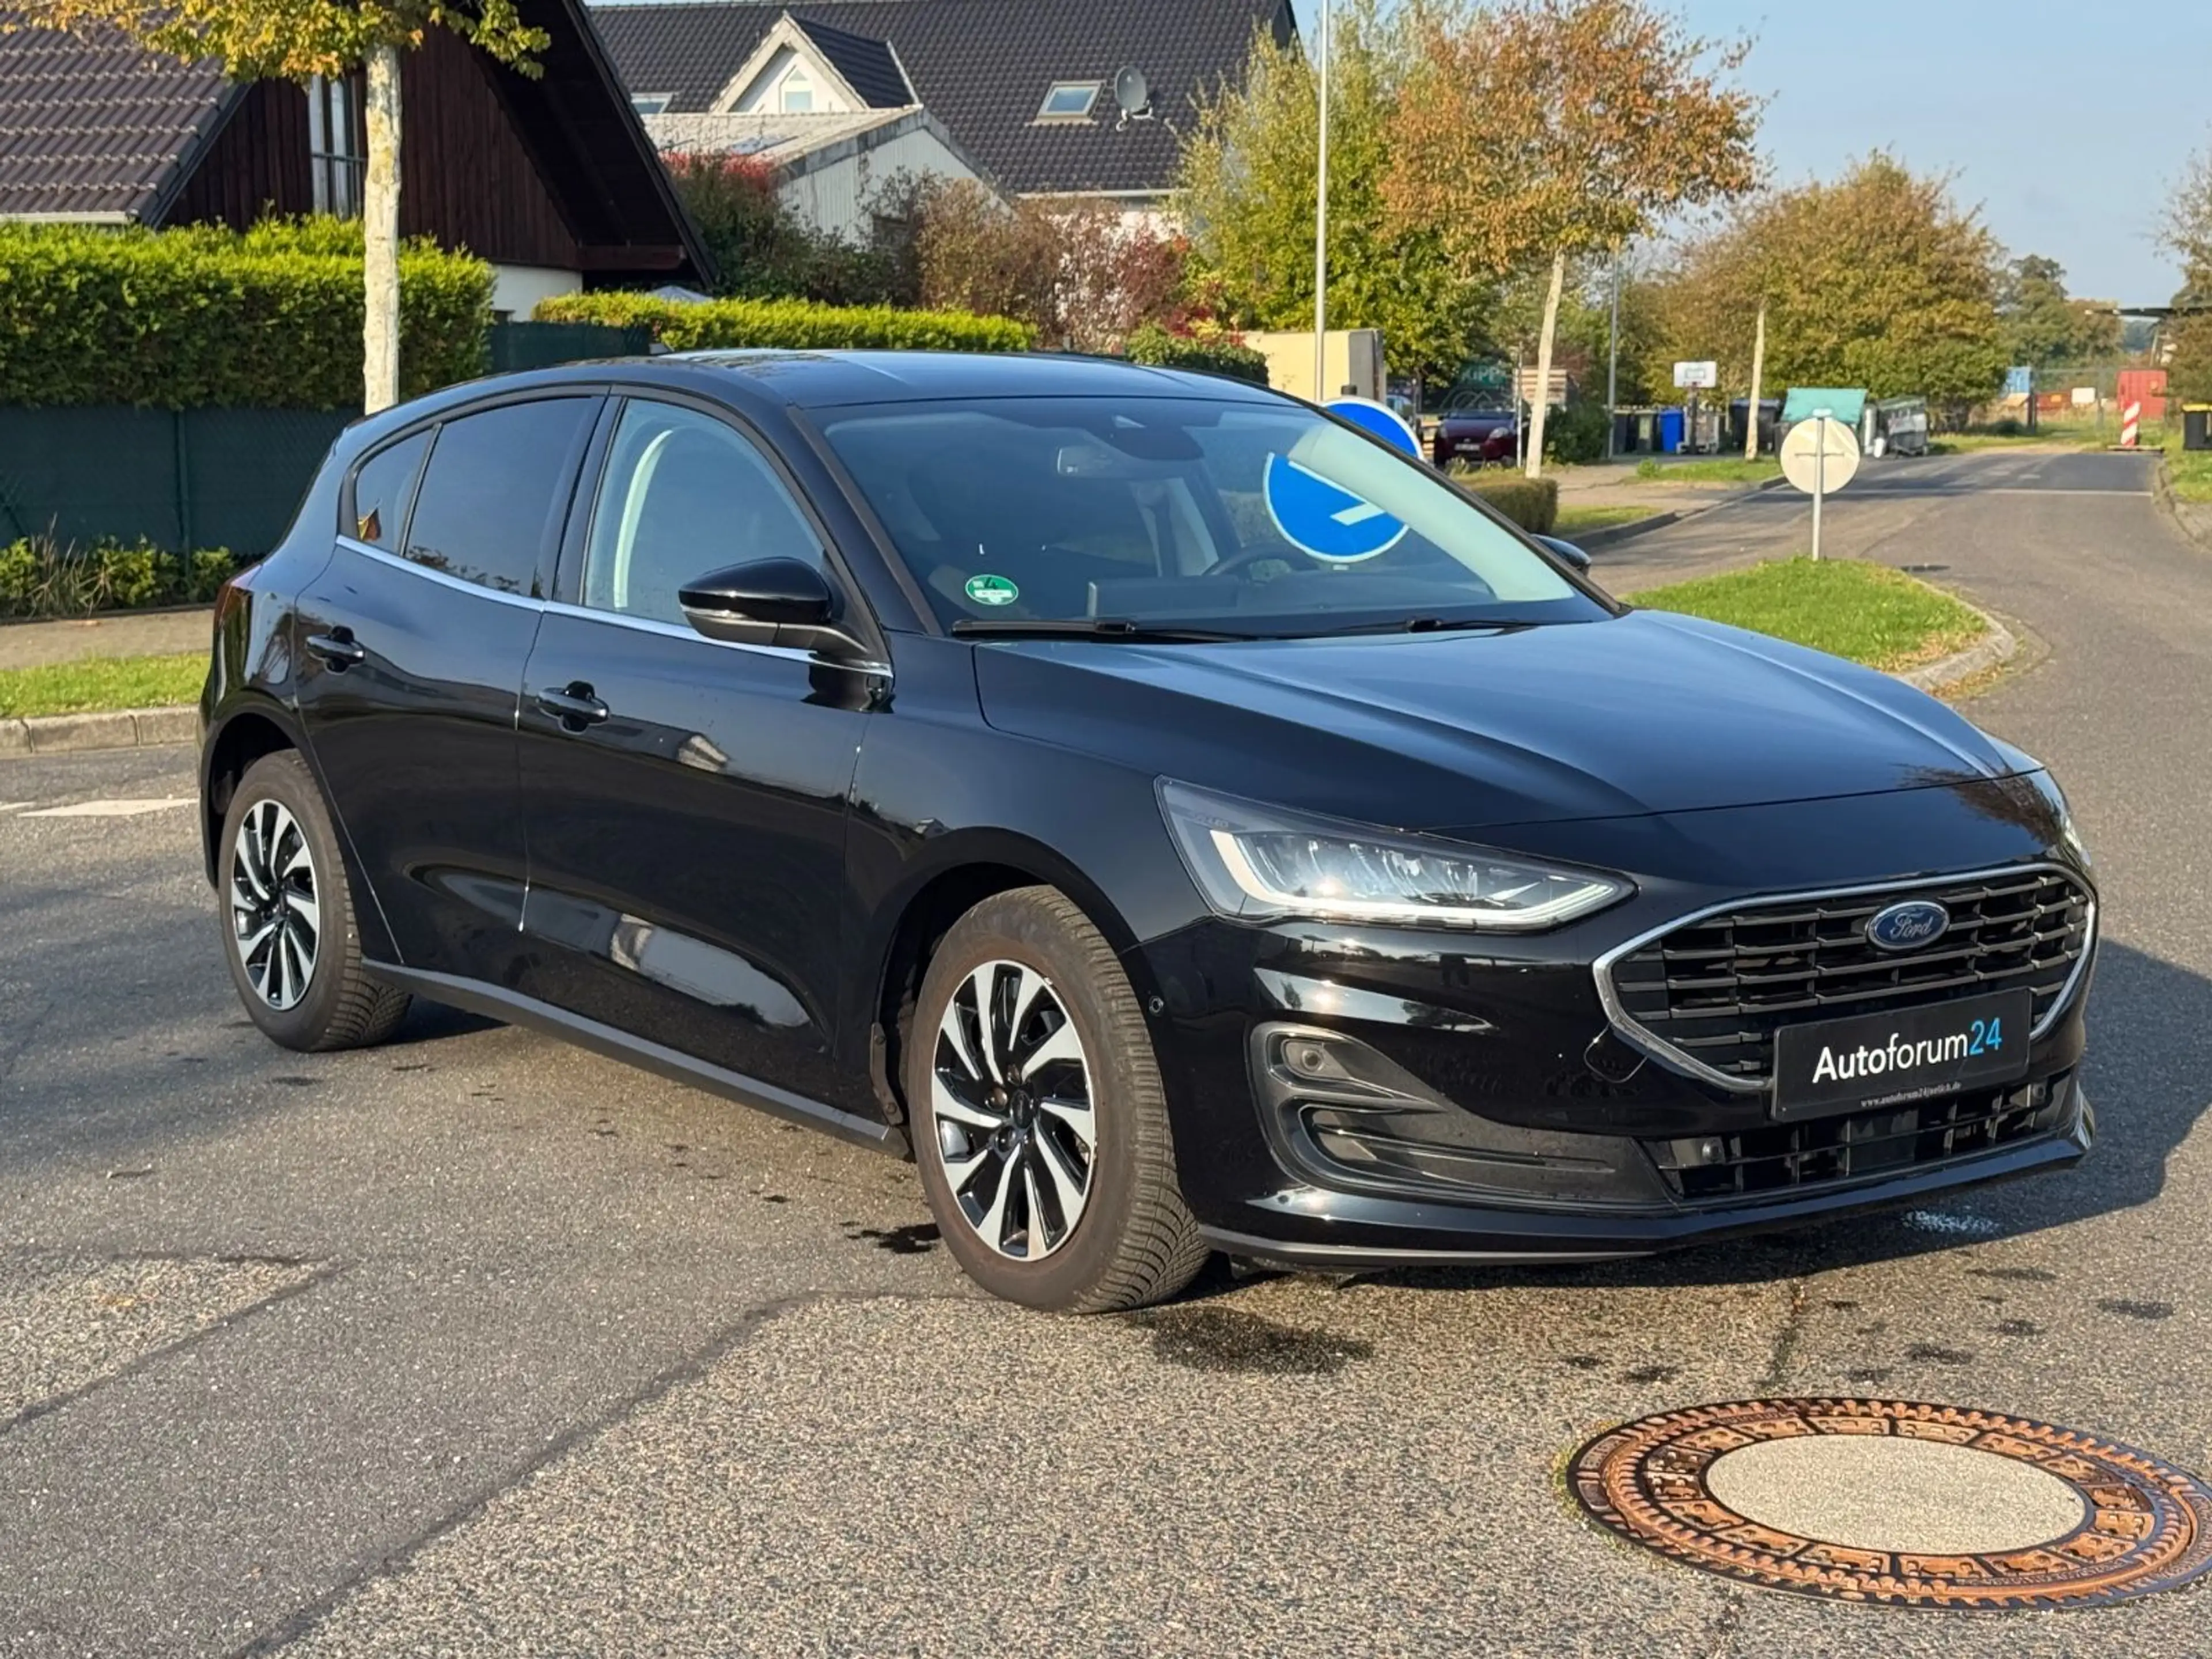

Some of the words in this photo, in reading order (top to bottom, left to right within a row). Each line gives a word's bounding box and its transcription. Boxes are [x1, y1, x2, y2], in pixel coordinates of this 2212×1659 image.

[984, 577, 998, 590] 4
[1889, 912, 1934, 940] Ford
[1812, 1017, 2002, 1083] Autoforum24
